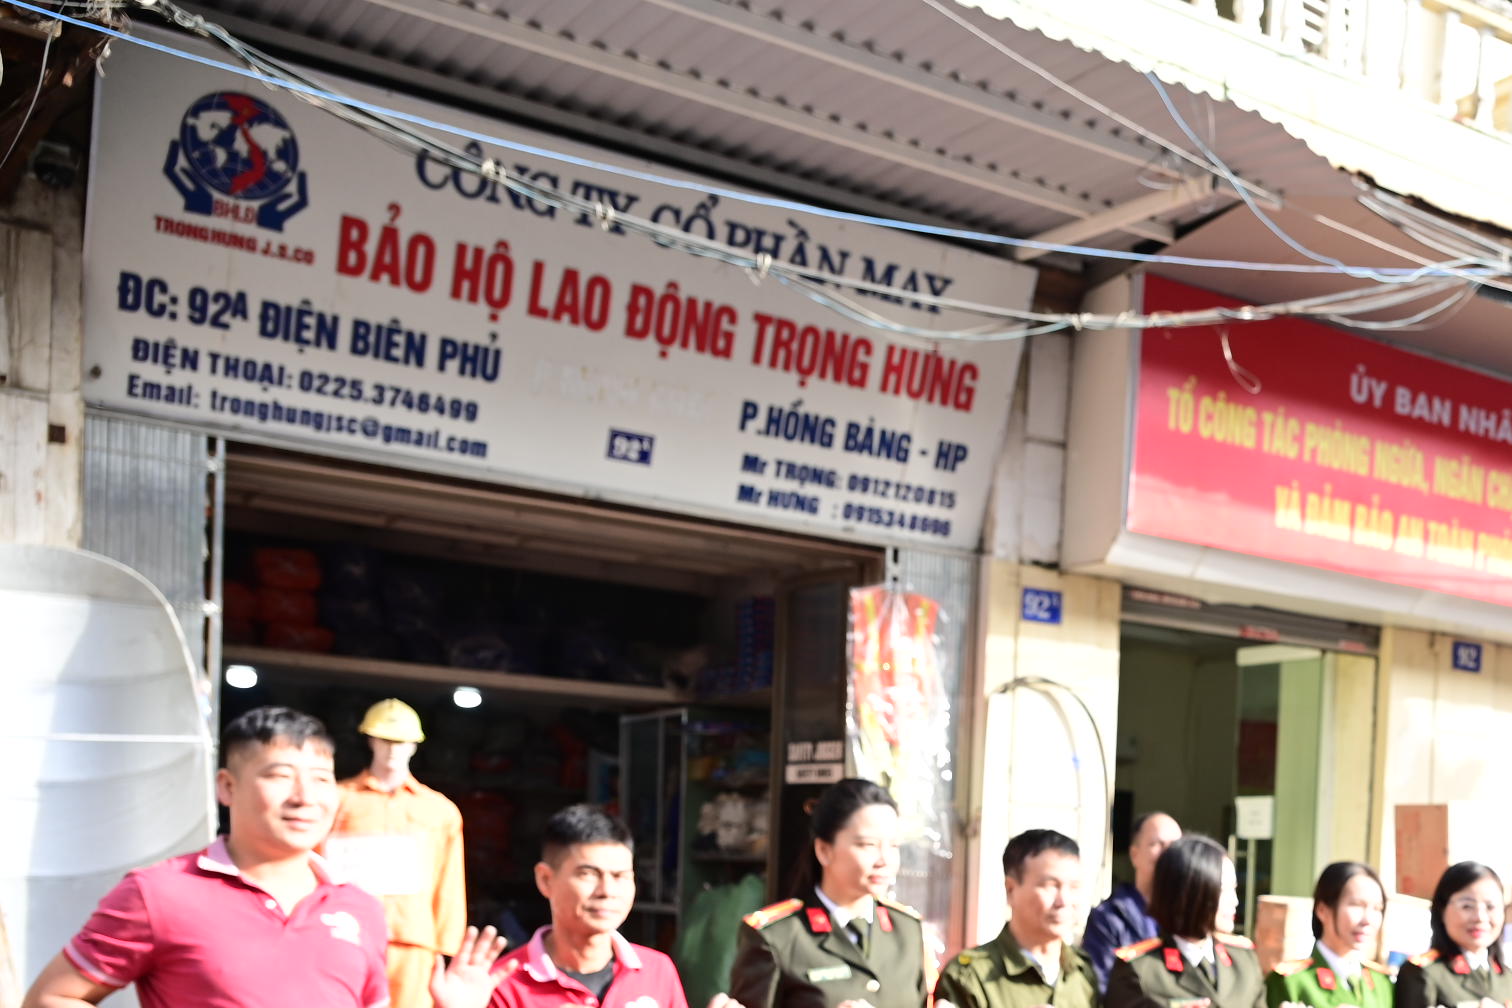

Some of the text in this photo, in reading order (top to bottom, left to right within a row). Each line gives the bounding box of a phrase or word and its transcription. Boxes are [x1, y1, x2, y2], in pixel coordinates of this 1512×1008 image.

[415, 141, 954, 314] CÔNG TY CỔ PHẦN MAY
[117, 270, 179, 323] ĐC:
[258, 298, 339, 353] ĐIỆN
[349, 316, 428, 369] BIÊN
[437, 331, 502, 383] PHỦ
[336, 202, 437, 294] BẢO
[450, 239, 514, 322] HỘ
[527, 259, 613, 332] LAO
[624, 281, 737, 359] ĐỘNG
[751, 312, 874, 389] TRỌNG
[131, 337, 199, 375] ĐIỆN
[207, 352, 293, 393] THOẠI:
[1350, 363, 1388, 408] ỦY
[1394, 385, 1452, 428] BAN
[127, 373, 488, 459] Email: tronghungjsc@gmail.com
[1167, 375, 1197, 434] TỔ
[1199, 390, 1257, 449] CÔNG
[1262, 406, 1300, 460] TÁC
[1303, 420, 1371, 477] PHÒNG
[1432, 454, 1485, 506] NGĂN
[741, 453, 767, 476] Mr
[934, 440, 968, 472] HP
[737, 484, 762, 504] Mr
[1457, 645, 1478, 668] 92
